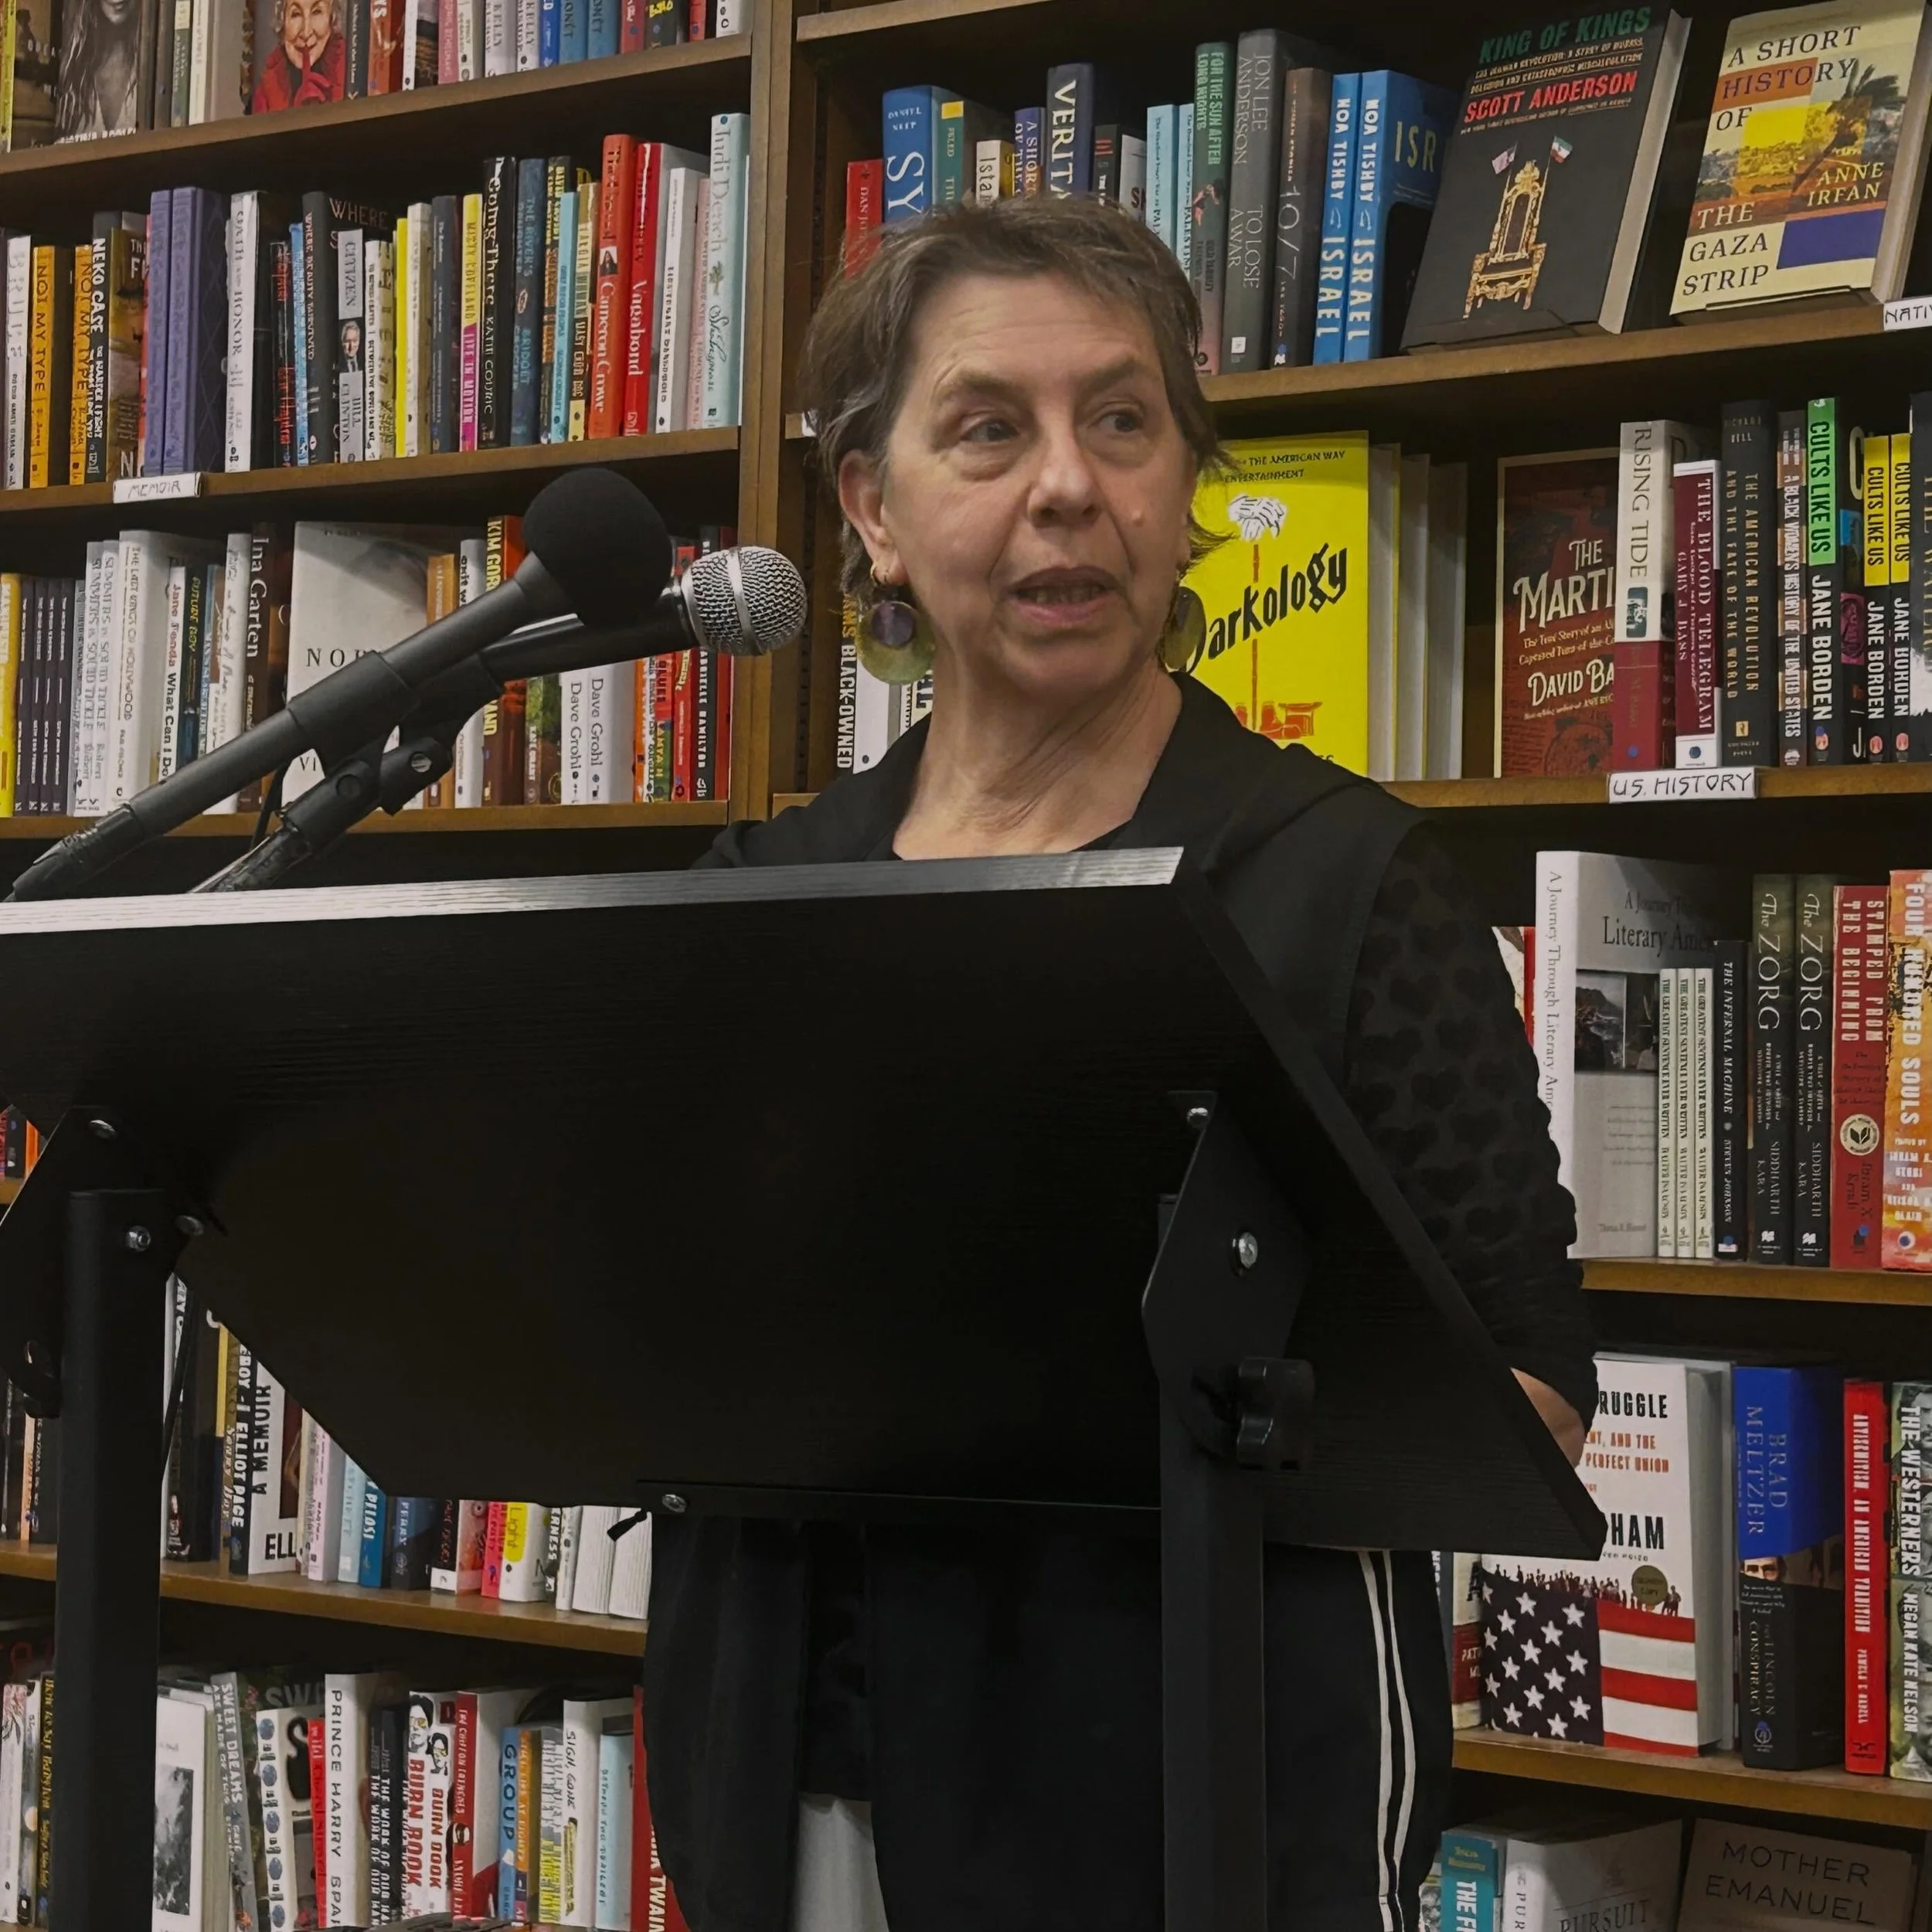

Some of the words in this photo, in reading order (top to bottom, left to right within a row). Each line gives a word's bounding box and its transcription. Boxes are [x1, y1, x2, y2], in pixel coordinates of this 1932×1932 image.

[1479, 30, 1532, 64] KING
[1539, 21, 1570, 50] OF
[1575, 6, 1651, 43] KINGS
[1727, 46, 1745, 69] A
[1756, 26, 1862, 61] SHORT
[1253, 54, 1270, 90] JON
[1722, 57, 1859, 100] HISTORY
[1234, 56, 1251, 165] ANDERSON
[1252, 97, 1268, 131] LEE
[1335, 97, 1350, 134] NOA
[1363, 99, 1379, 137] NOA
[1464, 91, 1525, 123] SCOTT
[1529, 70, 1638, 110] ANDERSON
[1715, 107, 1753, 131] OF
[1329, 141, 1347, 200] TISHBY
[1359, 142, 1377, 202] TISHBY
[1816, 162, 1885, 188] ANNE
[329, 196, 388, 228] WHERE
[860, 187, 869, 213] DAN
[1230, 207, 1243, 224] A
[1696, 202, 1755, 230] THE
[1806, 182, 1881, 208] IRFAN
[1246, 205, 1263, 233] TO
[1276, 185, 1301, 280] 10/7
[91, 238, 106, 285] NEKO
[1227, 229, 1241, 268] WAR
[1243, 240, 1262, 288] LOSE
[1688, 233, 1768, 263] GAZA
[344, 241, 357, 308] CITIZEN
[1316, 236, 1345, 338] ISRAEL
[1347, 237, 1375, 341] ISRAEL
[1682, 264, 1769, 297] STRIP
[231, 291, 243, 357] HONOR
[628, 279, 648, 376] Vagabond
[35, 348, 46, 392] TYPE
[1249, 456, 1267, 467] THE
[1324, 450, 1345, 461] WAY
[1631, 427, 1652, 512] RISING
[1810, 420, 1830, 479] CULTS
[1696, 478, 1713, 523] THE
[1726, 470, 1738, 498] AND
[1744, 473, 1759, 500] THE
[1811, 483, 1832, 525] LIKE
[1866, 466, 1884, 510] CULTS
[486, 520, 503, 550] KIM
[1726, 506, 1738, 533] THE
[1811, 529, 1832, 553] US
[1867, 512, 1884, 544] LIKE
[1894, 508, 1910, 540] LIKE
[250, 536, 270, 573] Ina
[1569, 539, 1603, 571] THE
[1630, 520, 1649, 578] TIDE
[1697, 532, 1713, 605] BLOOD
[1726, 543, 1738, 578] FATE
[1744, 509, 1759, 588] AMERICAN
[1868, 547, 1885, 566] US
[1894, 542, 1910, 563] US
[485, 554, 502, 592] GOR
[1726, 586, 1738, 603] OF
[246, 579, 267, 658] Garten
[1512, 566, 1614, 634] MARTI
[1811, 575, 1832, 630] JANE
[1867, 600, 1886, 645] JANE
[1893, 597, 1909, 641] JANE
[1726, 612, 1738, 639] THE
[1745, 596, 1760, 692] REVOLUTION
[165, 672, 177, 710] What
[699, 649, 708, 703] ABRIELLE
[1528, 669, 1583, 706] DAVID
[1586, 658, 1614, 693] BA
[1697, 613, 1713, 730] TELEGRAM
[1726, 648, 1738, 699] WORLD
[1812, 636, 1832, 721] BORDEN
[1868, 651, 1886, 719] BORDEN
[570, 682, 582, 722] Dave
[590, 678, 604, 717] Dave
[837, 645, 855, 769] BLACK-OWNED
[163, 716, 175, 743] Can
[570, 726, 582, 769] Grohl
[590, 723, 604, 766] Grohl
[698, 710, 707, 768] HAMILTON
[161, 757, 172, 777] Do
[1655, 773, 1751, 796] HISTORY
[1760, 893, 1778, 928] The
[1801, 893, 1820, 928] The
[1842, 900, 1860, 934] THE
[1903, 883, 1923, 937] FOUR
[1866, 900, 1884, 980] STAMPED
[1723, 961, 1733, 987] THE
[1757, 933, 1781, 1031] ZORG
[1800, 933, 1823, 1031] ZORG
[1840, 947, 1860, 1042] BEGINNING
[1902, 947, 1923, 1046] HUNDRED
[1723, 991, 1733, 1052] INFERNAL
[1865, 997, 1884, 1042] FROM
[1723, 1056, 1733, 1114] MACHINE
[1900, 1057, 1920, 1125] SOULS
[238, 1344, 252, 1389] EBOY
[1599, 1390, 1668, 1419] RUGGLE
[1900, 1406, 1921, 1439] THE
[233, 1421, 249, 1481] ELLIOT
[1746, 1405, 1764, 1536] MELTZER
[1768, 1433, 1787, 1509] BRAD
[232, 1485, 246, 1528] PAGE
[362, 1492, 379, 1539] PELOSI
[1900, 1448, 1921, 1576] WESTERNERS
[1611, 1512, 1665, 1549] HAM
[1903, 1593, 1919, 1638] MEGAN
[1903, 1641, 1919, 1677] KATE
[221, 1682, 237, 1733] SWEET
[1903, 1680, 1919, 1732] NELSON
[331, 1690, 342, 1772] PRINCE
[226, 1740, 243, 1804] DREAMS
[407, 1759, 425, 1819] BURN
[502, 1743, 517, 1841] GROUP
[331, 1783, 342, 1858] HARRY
[430, 1787, 444, 1835] BURN
[406, 1826, 423, 1887] BOOK
[430, 1842, 443, 1889] BOOK
[1723, 1839, 1870, 1887] MOTHER
[1456, 1881, 1477, 1912] THE
[1705, 1874, 1876, 1925] EMANUEL
